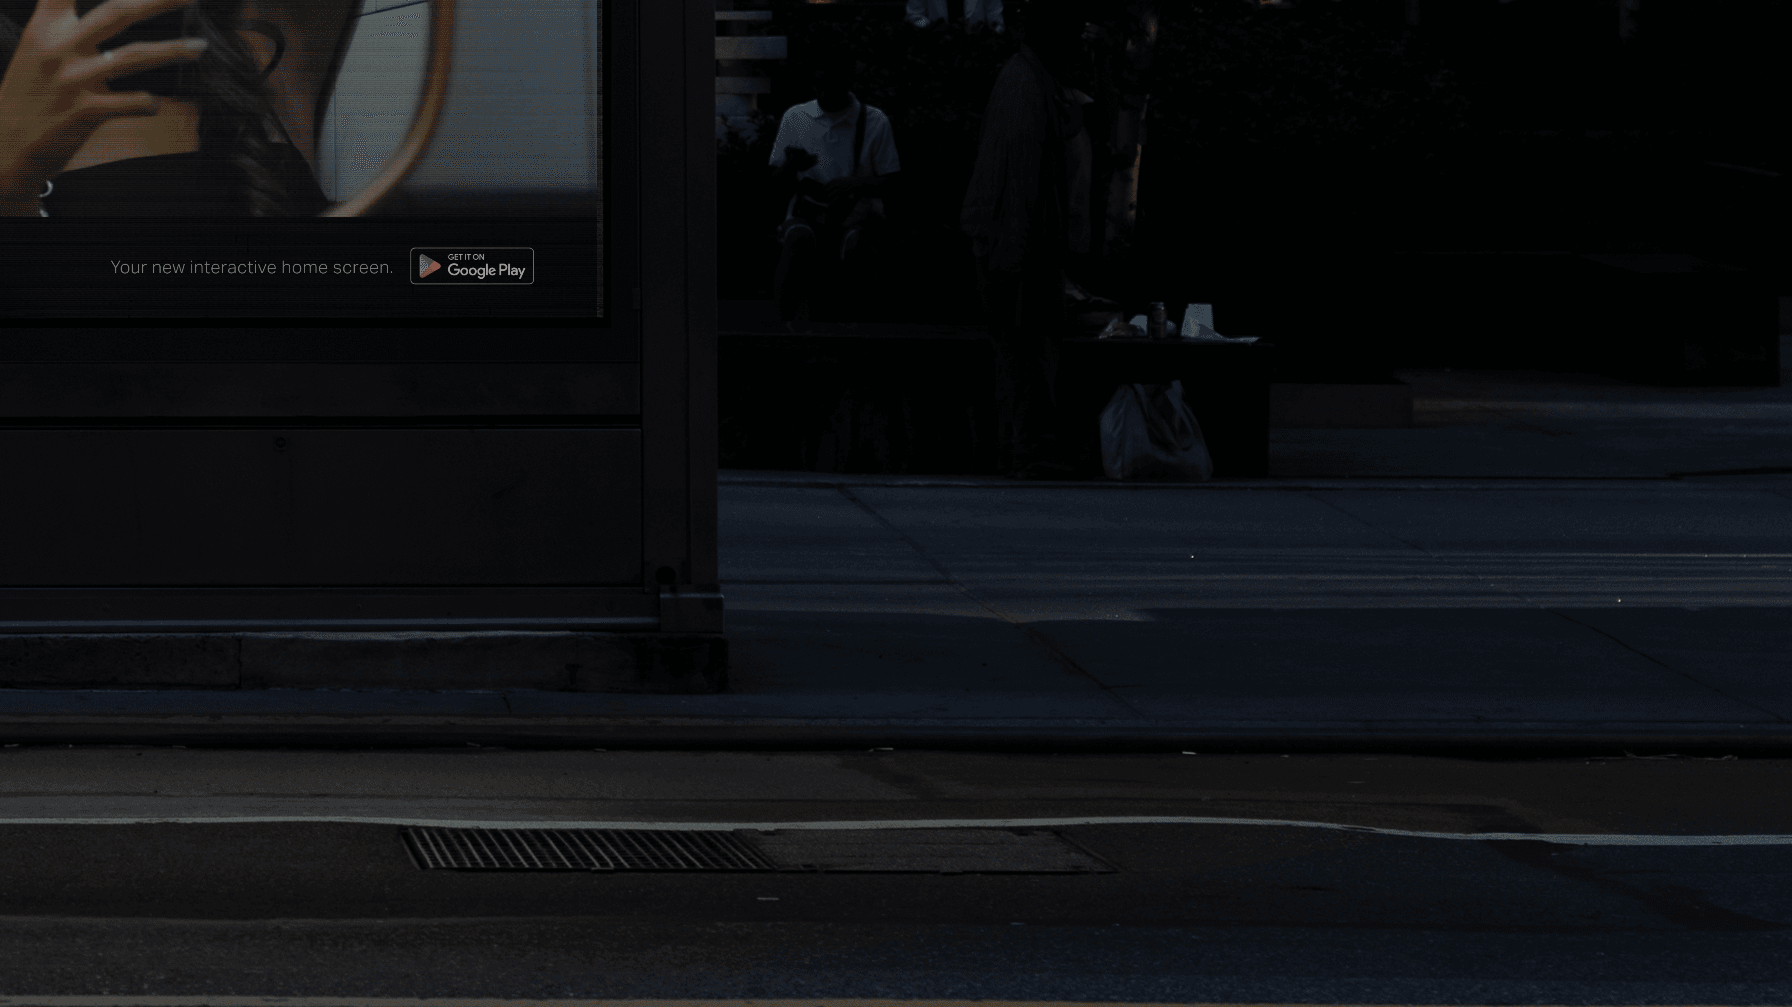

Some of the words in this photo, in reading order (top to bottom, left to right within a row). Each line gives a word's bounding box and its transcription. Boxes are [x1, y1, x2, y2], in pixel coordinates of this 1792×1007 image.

[447, 253, 464, 261] GET
[464, 253, 472, 261] IT
[472, 253, 485, 261] ON
[110, 260, 148, 275] Your
[152, 263, 186, 275] new
[190, 260, 277, 275] interactive
[282, 260, 328, 275] home
[333, 263, 393, 275] screen.
[447, 262, 497, 280] Google
[498, 263, 526, 280] Play
